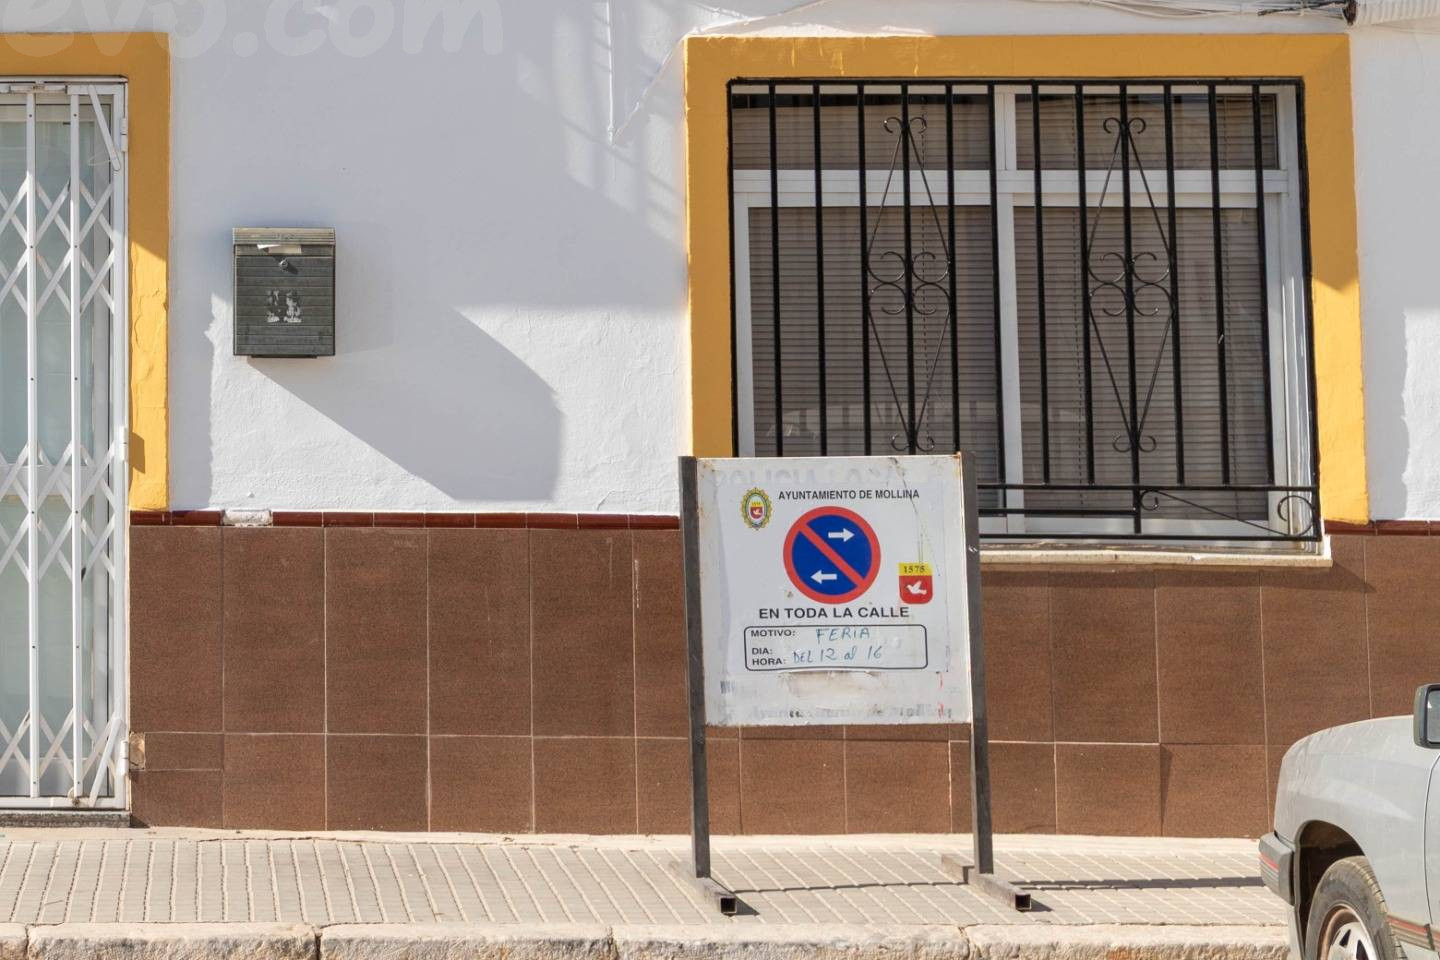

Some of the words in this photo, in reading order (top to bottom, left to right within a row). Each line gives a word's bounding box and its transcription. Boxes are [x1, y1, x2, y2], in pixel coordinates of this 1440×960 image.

[778, 489, 857, 501] AYUNTAMIENTO
[859, 490, 873, 500] DE
[875, 489, 920, 500] MOLLINA
[759, 608, 779, 619] EN
[784, 607, 828, 619] TODA
[833, 607, 853, 618] LA
[858, 606, 910, 618] CALLE
[750, 629, 796, 638] MOTIVO:
[815, 627, 871, 644] FERIA
[820, 648, 837, 661] 12
[867, 645, 883, 659] 16
[752, 657, 786, 666] HORA:
